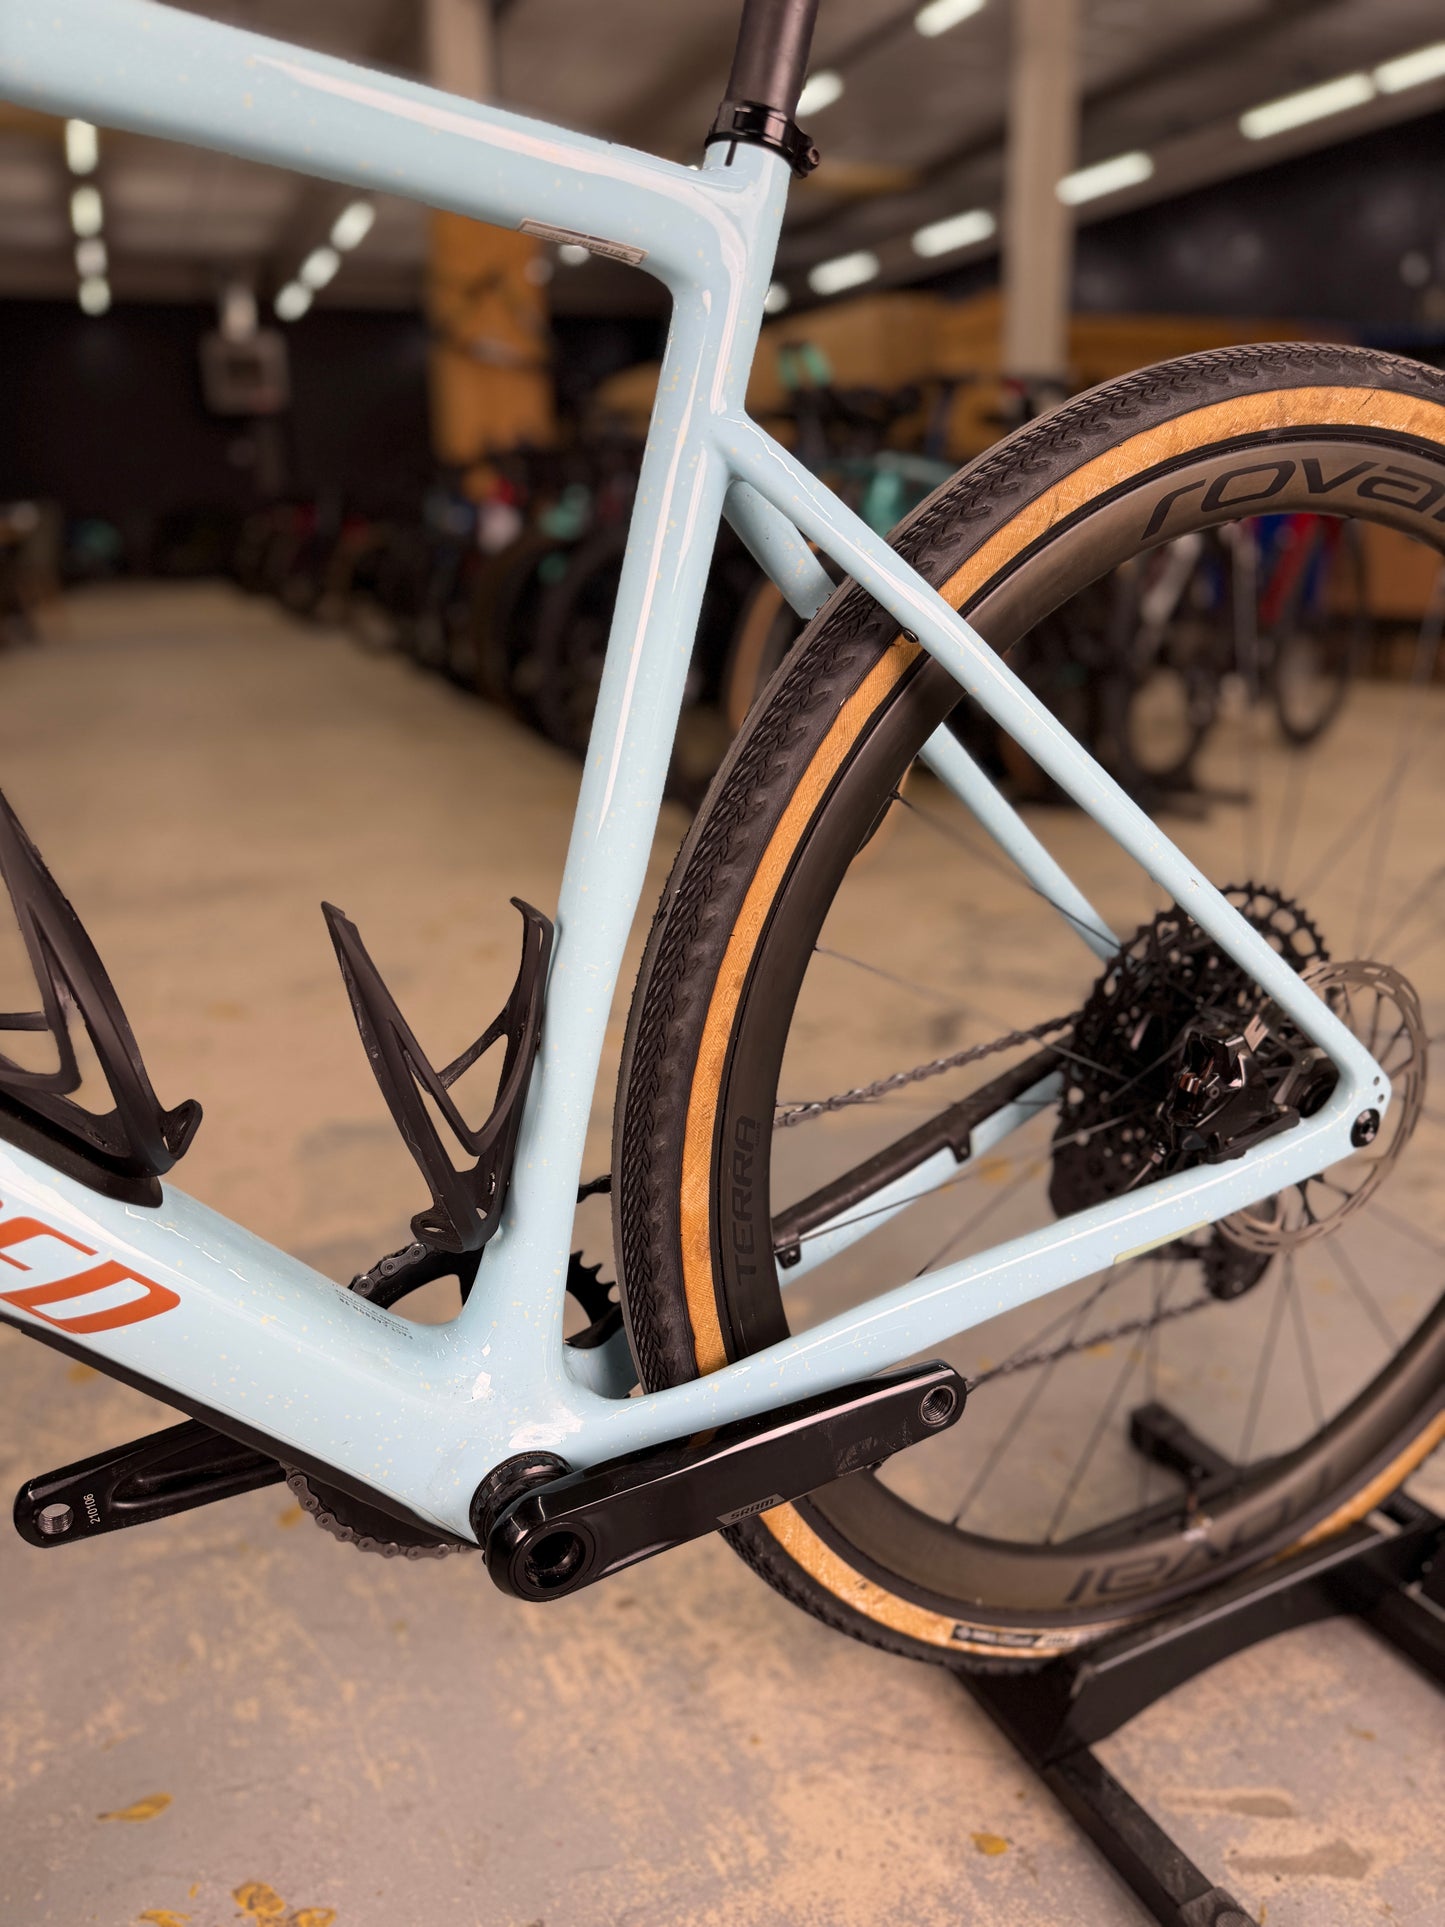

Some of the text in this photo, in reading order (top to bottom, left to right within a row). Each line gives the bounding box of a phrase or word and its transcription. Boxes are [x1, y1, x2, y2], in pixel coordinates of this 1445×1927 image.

[732, 1115, 757, 1286] TERRA
[83, 1493, 101, 1525] 210106
[729, 1497, 774, 1521] SRAM
